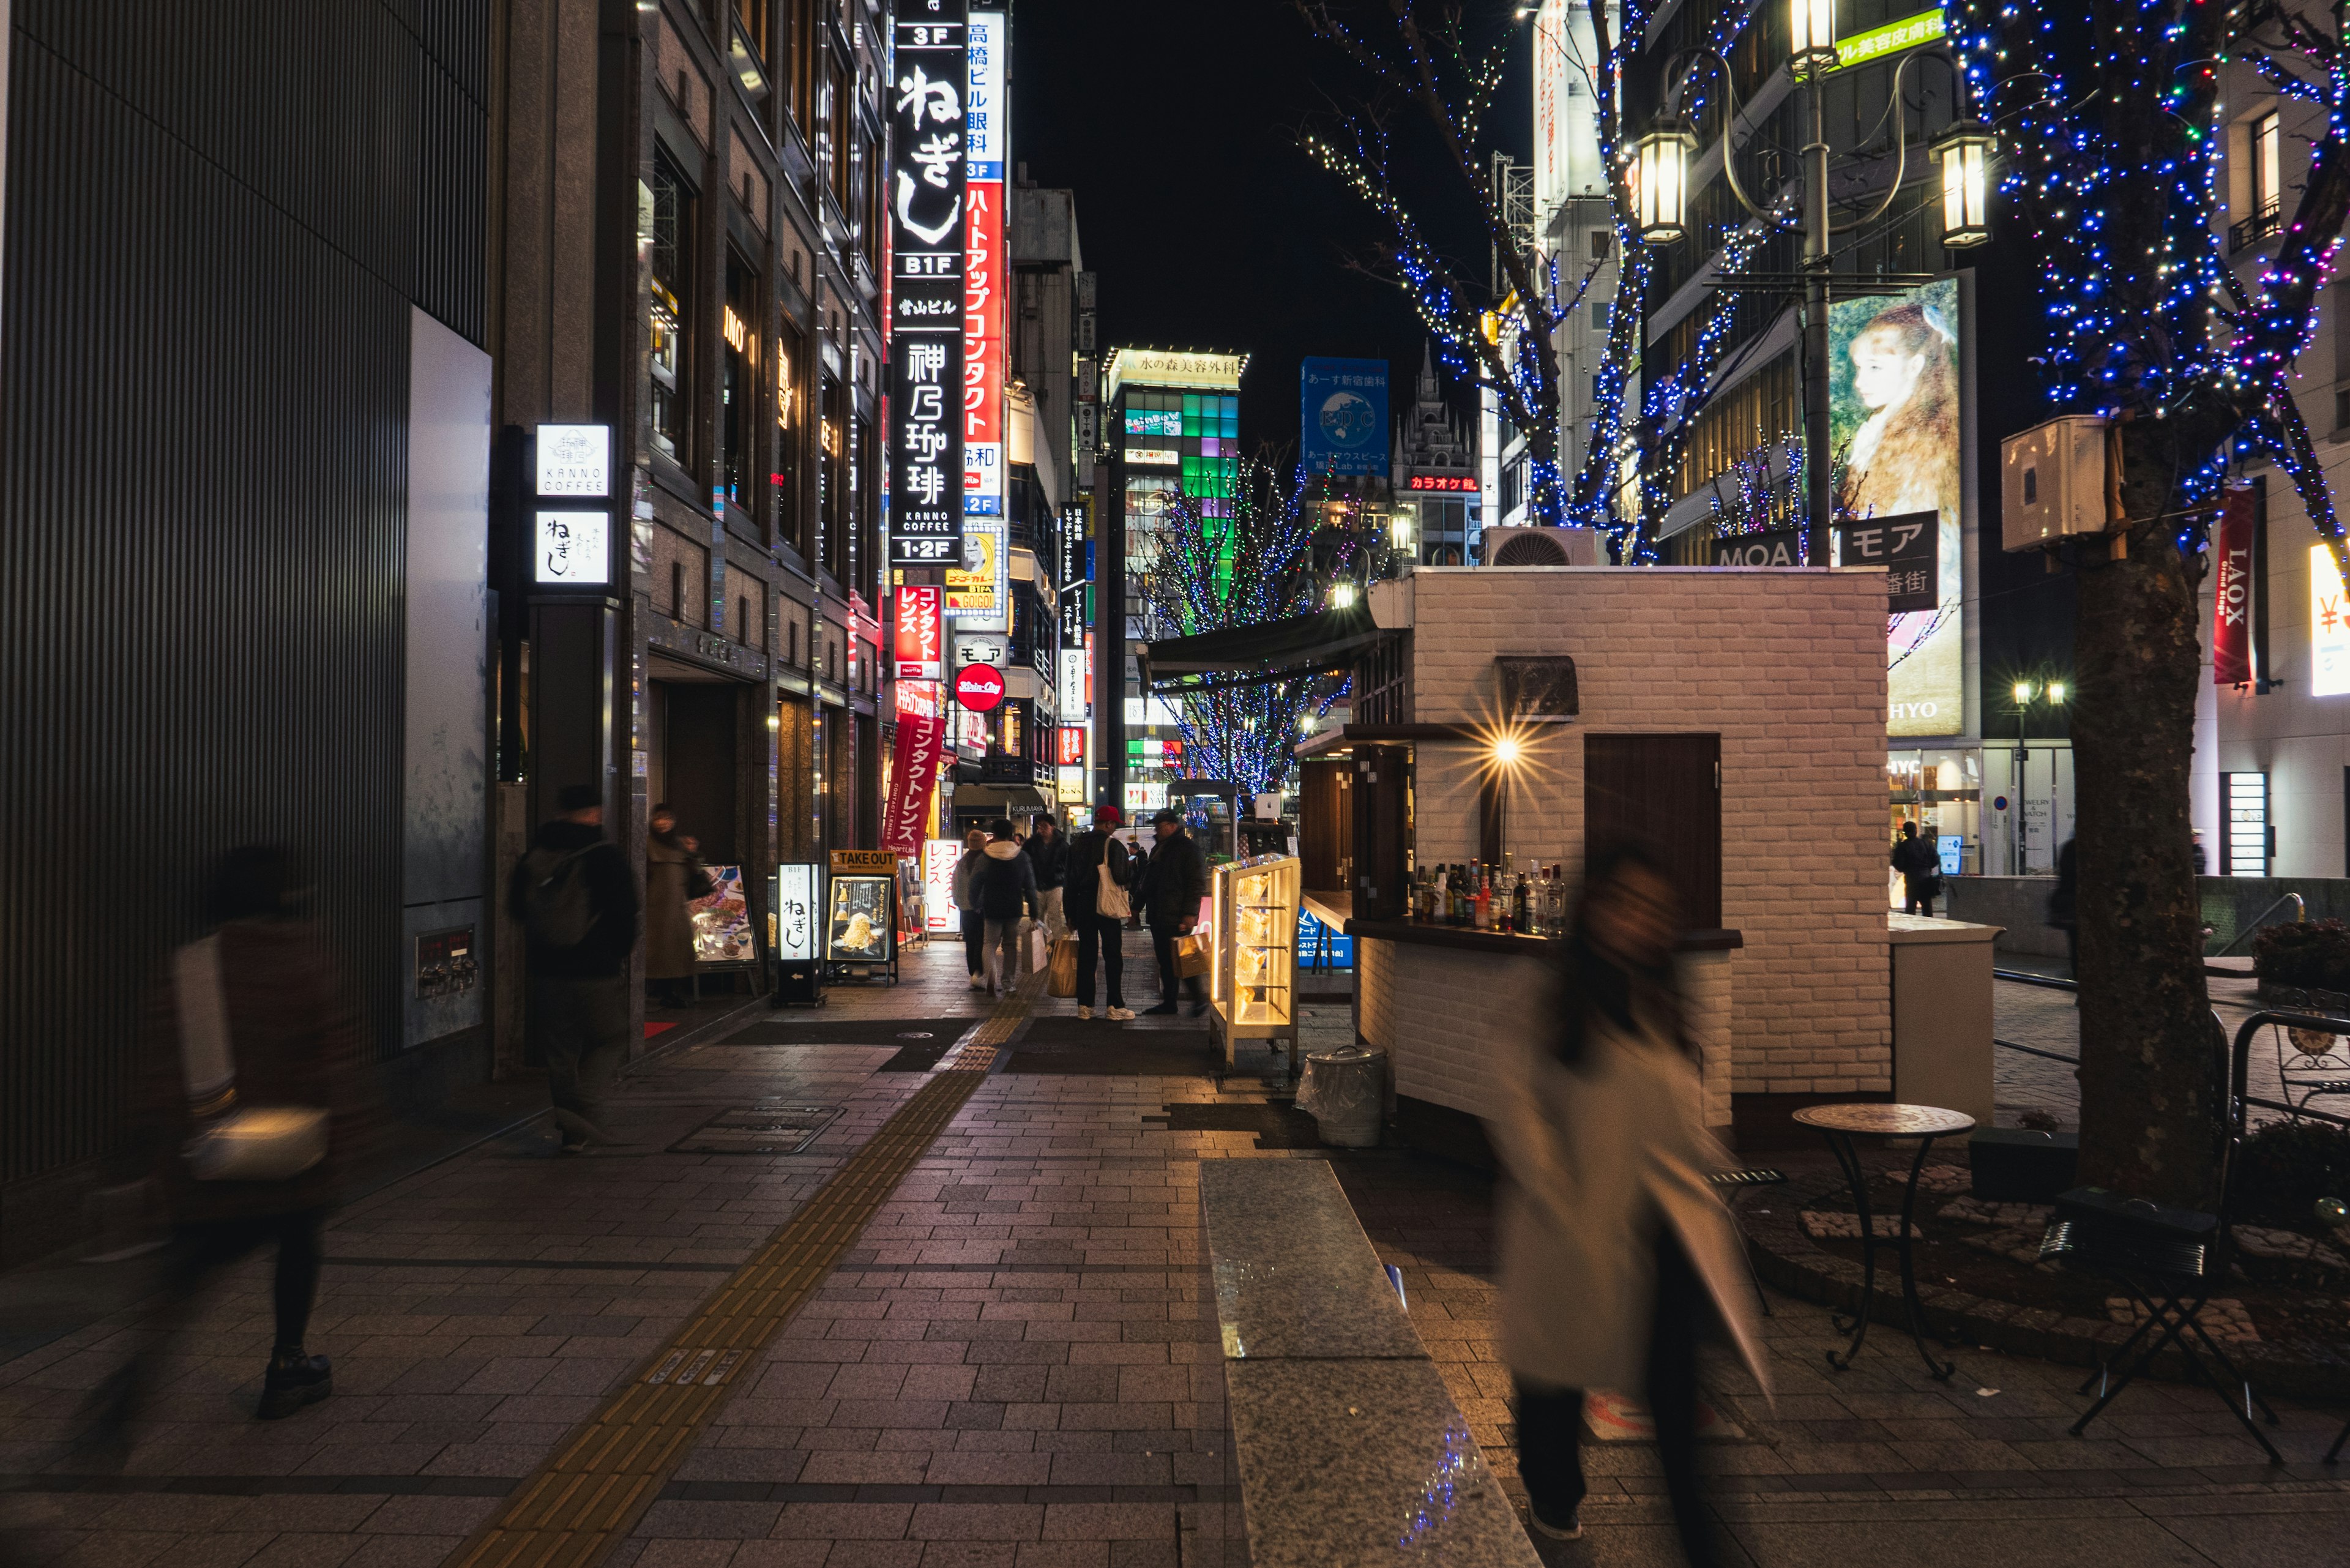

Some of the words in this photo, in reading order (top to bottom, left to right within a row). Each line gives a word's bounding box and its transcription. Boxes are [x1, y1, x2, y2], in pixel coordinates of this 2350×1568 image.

[913, 27, 948, 45] 3F
[1839, 15, 1944, 62] ル美容皮膚科
[968, 24, 988, 153] 高橋ビル眼科
[896, 65, 962, 244] ねぎし
[967, 163, 988, 177] 3F
[905, 256, 952, 274] B1F
[965, 190, 990, 436] ハートアップコンタクト
[1140, 357, 1236, 375] 水の森美容外科
[1308, 374, 1386, 387] あーす新宿歯科
[905, 344, 946, 505] 神乃珈琲
[545, 481, 603, 491] COFFEE
[546, 468, 600, 478] KANNO
[1411, 477, 1475, 490] カラオケ館
[903, 522, 949, 531] COFFEE
[906, 512, 949, 520] KANNO
[545, 517, 571, 577] ねぎし
[1852, 522, 1923, 558] モア
[1719, 541, 1792, 566] MOA
[2220, 561, 2229, 588] Grand
[2225, 548, 2248, 627] LAOX
[900, 587, 918, 633] レンズ
[2218, 589, 2227, 617] Stage
[919, 588, 936, 660] コンタクト
[961, 648, 1001, 662] モア
[1890, 701, 1938, 719] HYO
[897, 720, 934, 842] コンタクトレンズ
[840, 853, 869, 865] TAKE
[871, 853, 894, 865] OUT
[783, 897, 806, 949] ねぎし
